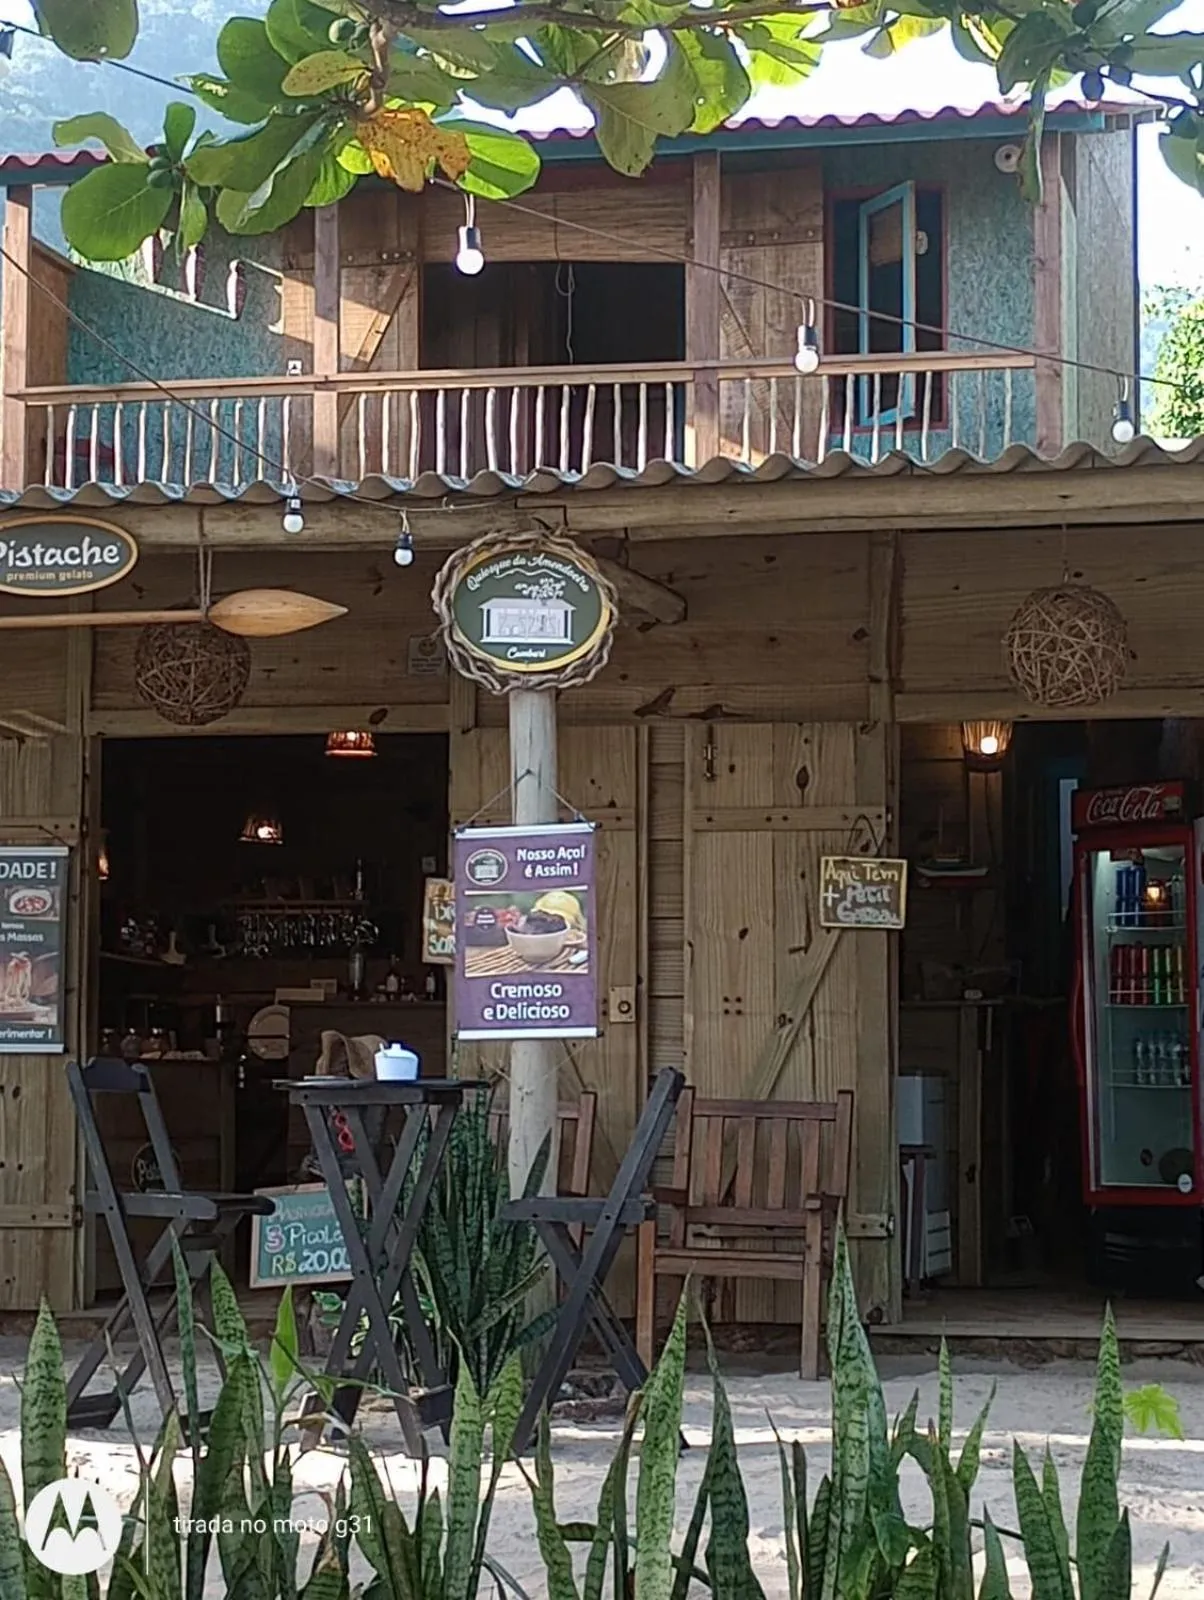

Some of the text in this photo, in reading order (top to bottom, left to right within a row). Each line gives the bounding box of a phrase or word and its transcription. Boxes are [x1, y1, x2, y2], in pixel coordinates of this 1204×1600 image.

[6, 570, 93, 583] premium gelato
[1086, 785, 1164, 824] Coca-Cola
[516, 848, 555, 862] Nosso
[556, 843, 586, 861] Açaí
[524, 863, 533, 878] é
[862, 863, 899, 882] Tem
[490, 983, 563, 999] Cremoso
[483, 1001, 570, 1020] e Delicioso
